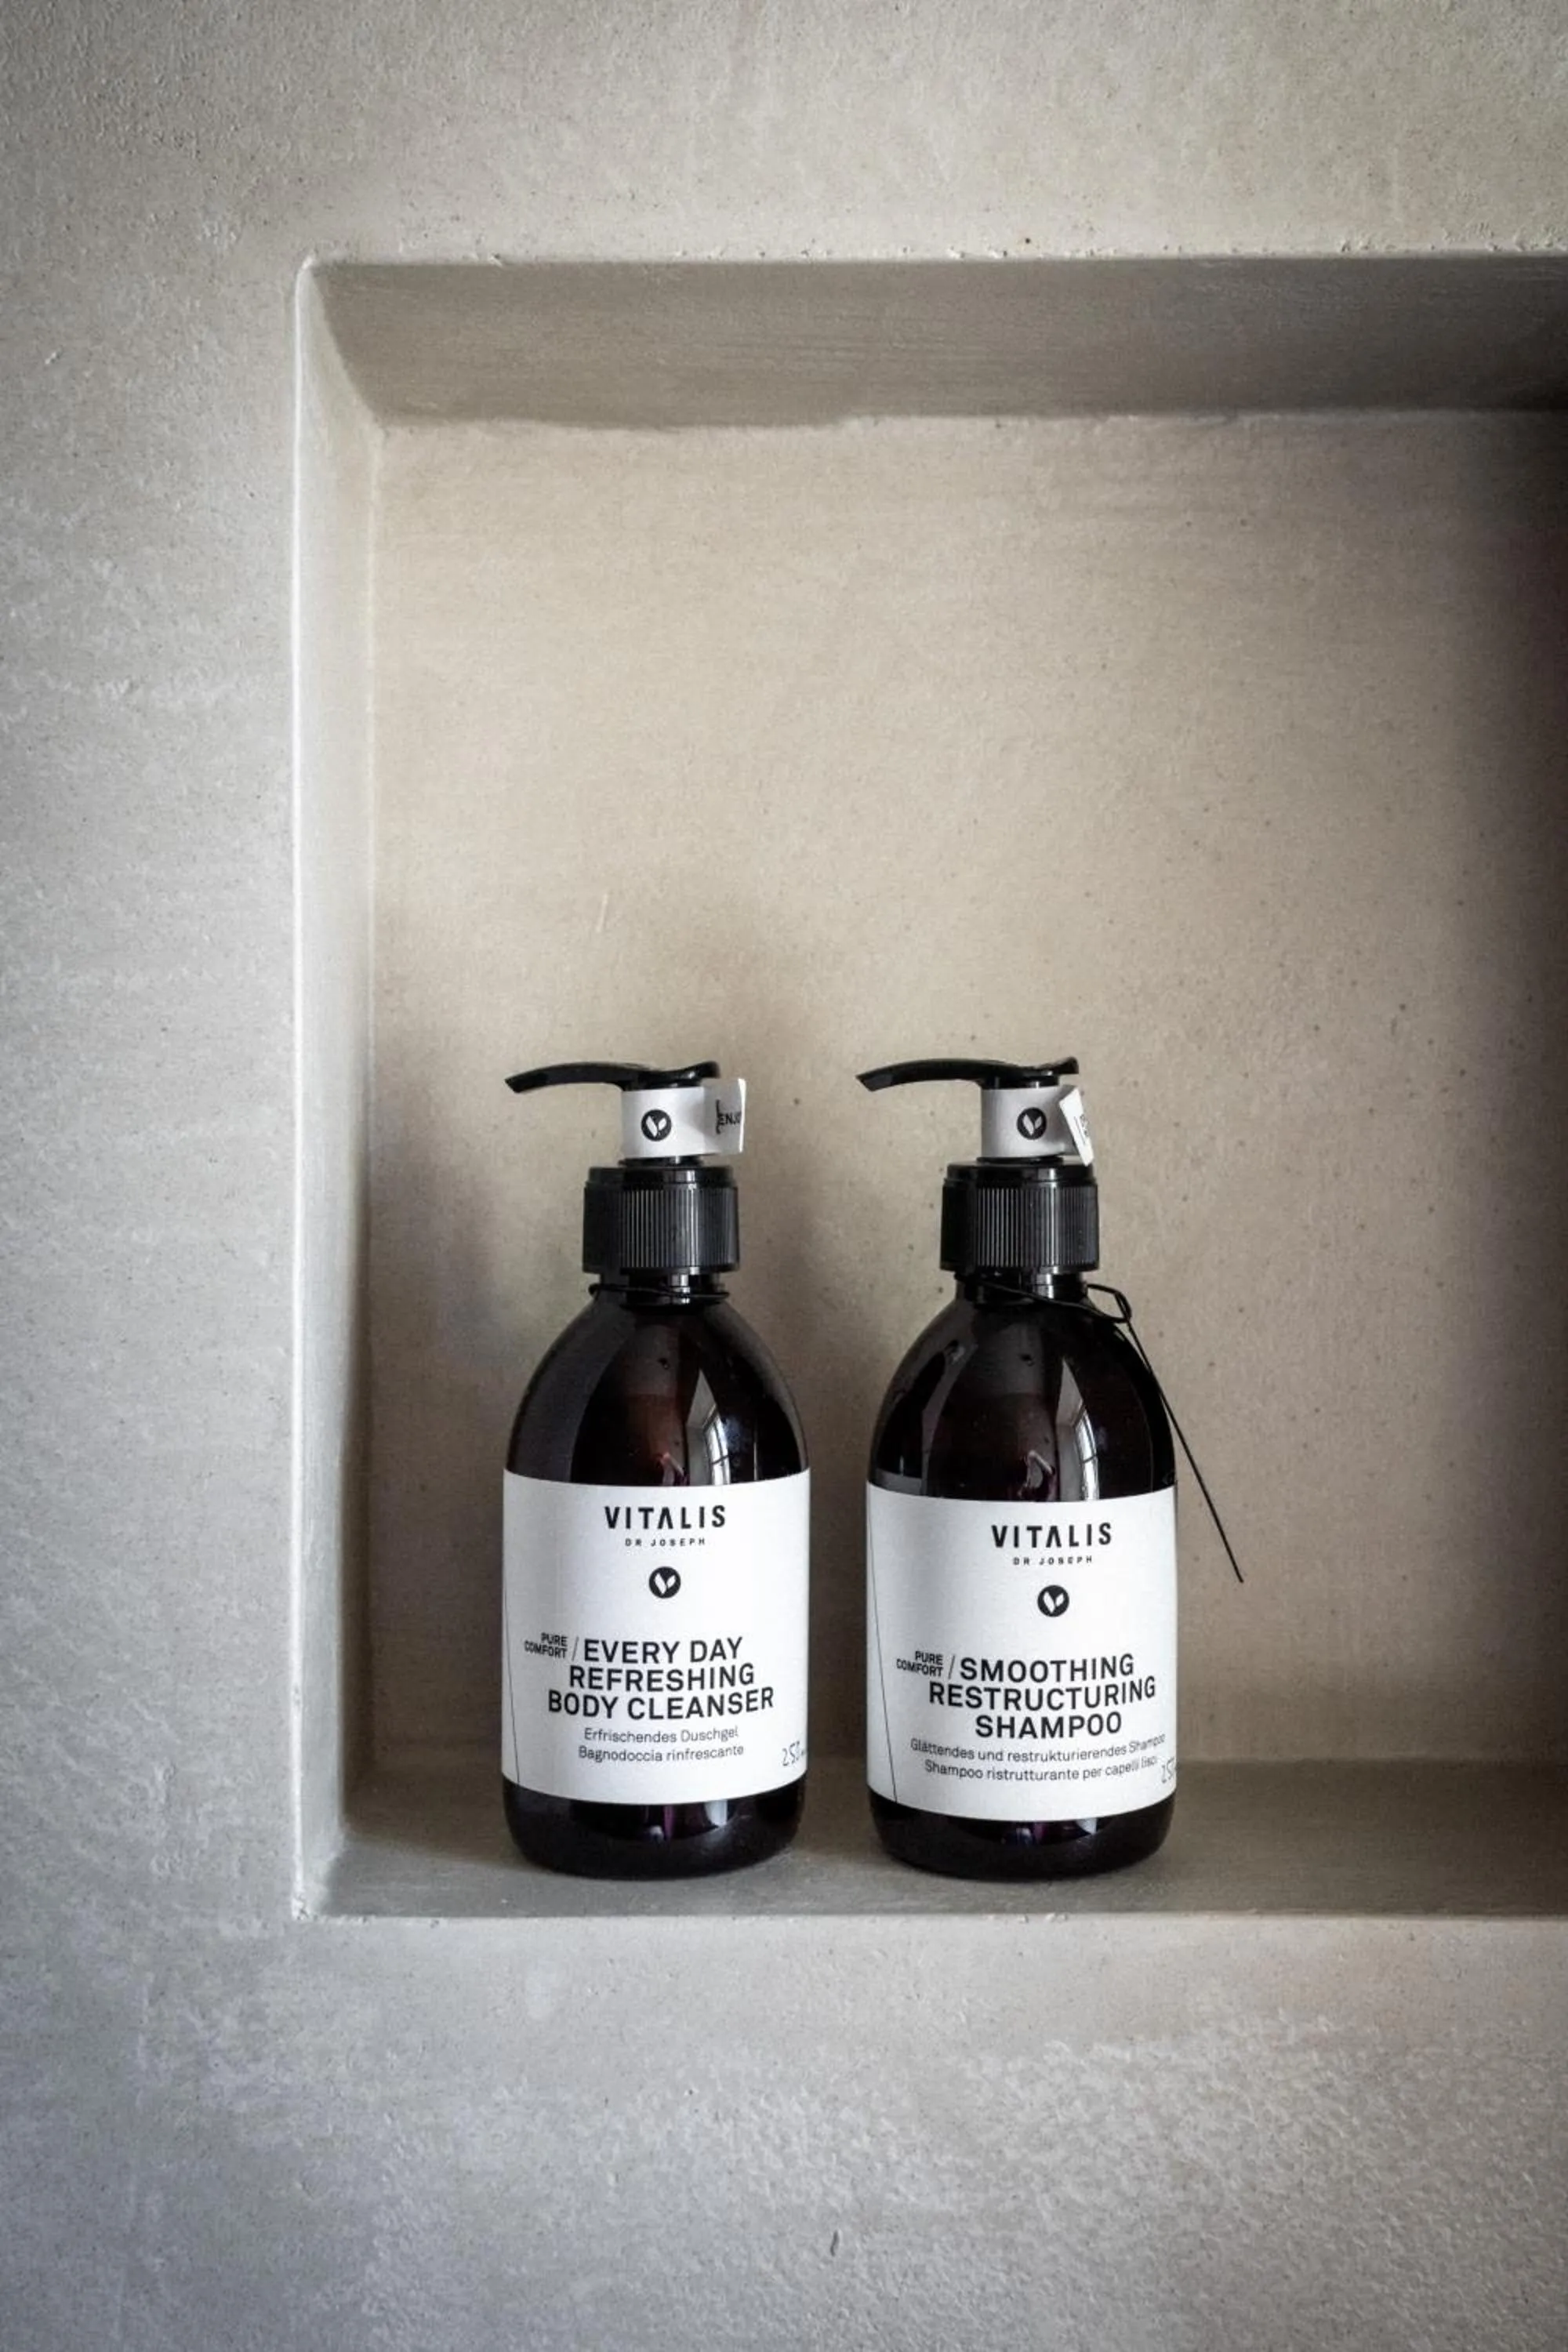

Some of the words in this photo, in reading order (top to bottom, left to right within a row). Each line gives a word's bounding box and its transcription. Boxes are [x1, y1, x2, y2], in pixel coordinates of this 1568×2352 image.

[604, 1505, 725, 1529] VITALIS
[651, 1537, 706, 1546] JOSEPH
[991, 1523, 1112, 1548] VITALIS
[1039, 1555, 1092, 1565] JOSEPH
[524, 1640, 568, 1658] COMFORT
[541, 1632, 568, 1646] PURE
[584, 1639, 680, 1664] EVERY
[690, 1636, 742, 1663] DAY
[915, 1650, 943, 1665] PURE
[570, 1663, 754, 1692] REFRESHING
[897, 1658, 943, 1677] COMFORT
[960, 1653, 1134, 1683] SMOOTHING
[549, 1690, 619, 1719] BODY
[627, 1686, 774, 1720] CLEANSER
[929, 1675, 1156, 1711] RESTRUCTURING
[584, 1727, 677, 1743] Erfrischendes
[681, 1726, 738, 1741] Duschgel
[975, 1711, 1122, 1739] SHAMPOO
[579, 1745, 662, 1762] Bagnodoccia
[666, 1745, 744, 1761] rinfrescante
[978, 1748, 1004, 1761] und
[1007, 1745, 1127, 1763] restrukturierendes
[924, 1759, 983, 1779] Shampoo
[987, 1766, 1080, 1781] ristrutturante
[1083, 1767, 1102, 1780] per
